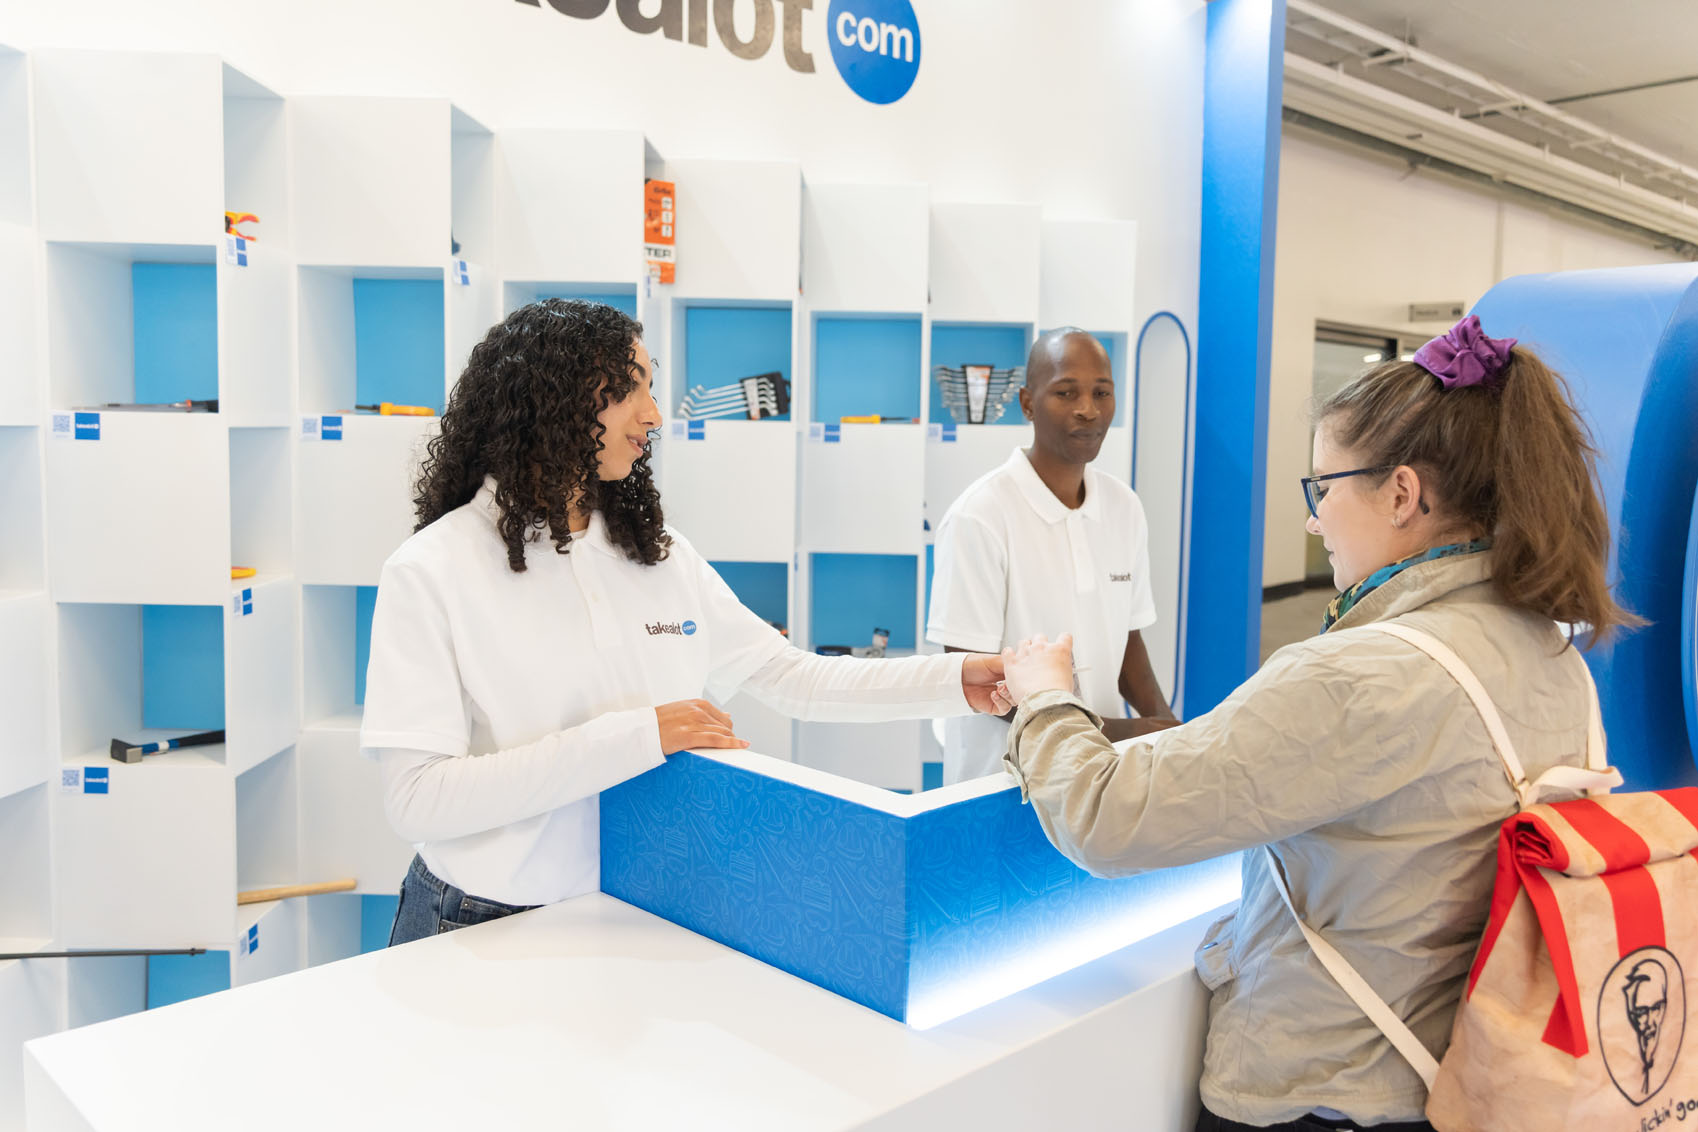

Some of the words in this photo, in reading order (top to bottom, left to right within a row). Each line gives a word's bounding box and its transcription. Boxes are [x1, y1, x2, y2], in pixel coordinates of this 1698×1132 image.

[836, 10, 914, 63] com
[645, 621, 682, 636] takealot
[1676, 1098, 1698, 1122] go
